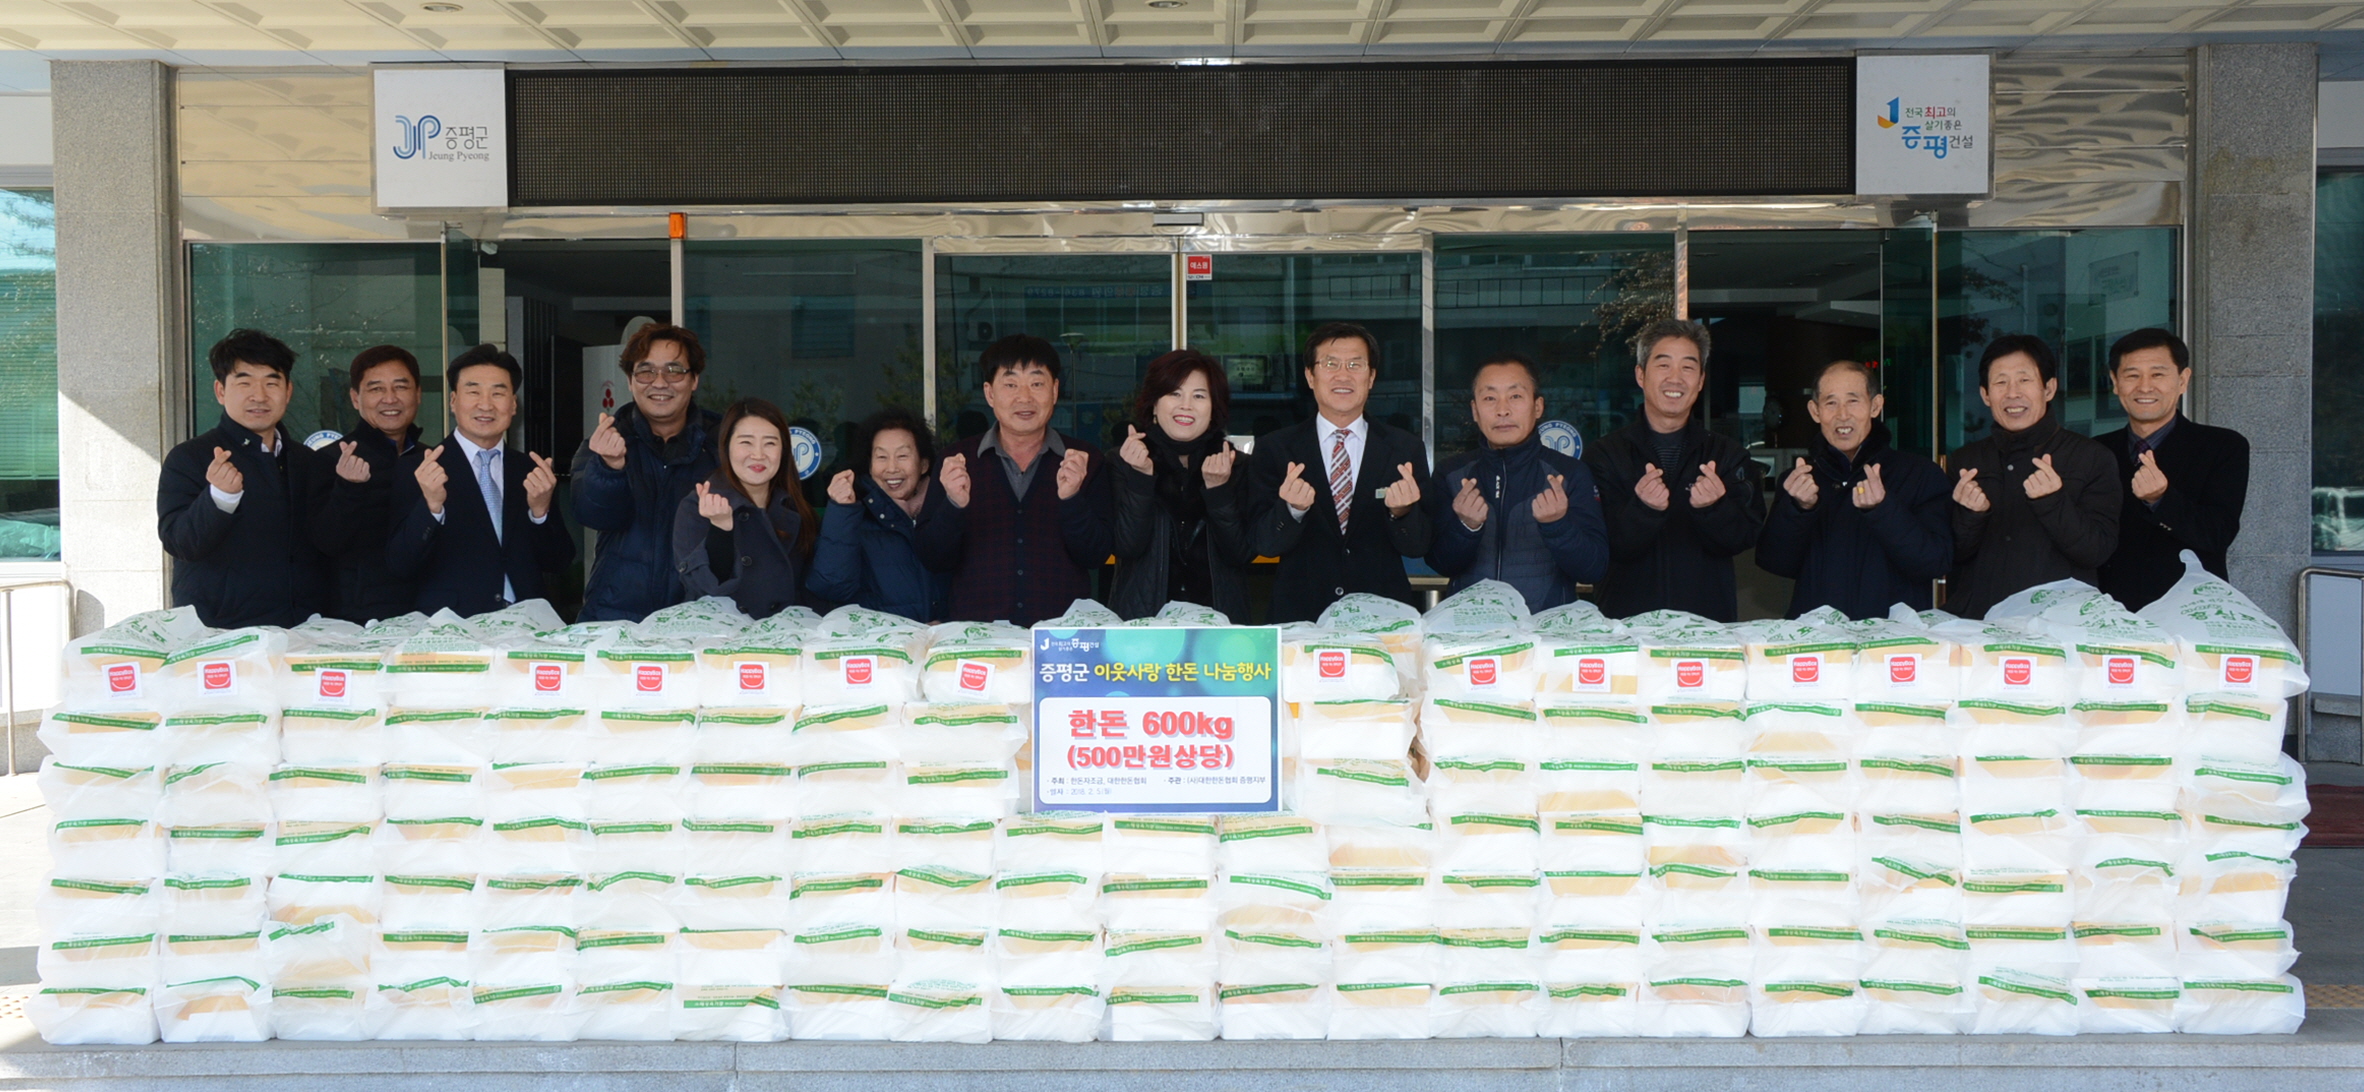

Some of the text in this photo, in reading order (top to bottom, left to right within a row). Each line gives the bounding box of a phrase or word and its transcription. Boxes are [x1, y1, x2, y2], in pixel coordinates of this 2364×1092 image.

[445, 126, 488, 150] 증평군
[428, 151, 490, 162] Jeung Pyeong
[1039, 662, 1272, 682] 증평군 이웃사랑 한돈 나눔행사
[1068, 709, 1234, 740] 한돈 600kg
[1067, 744, 1234, 769] (500만원상당)
